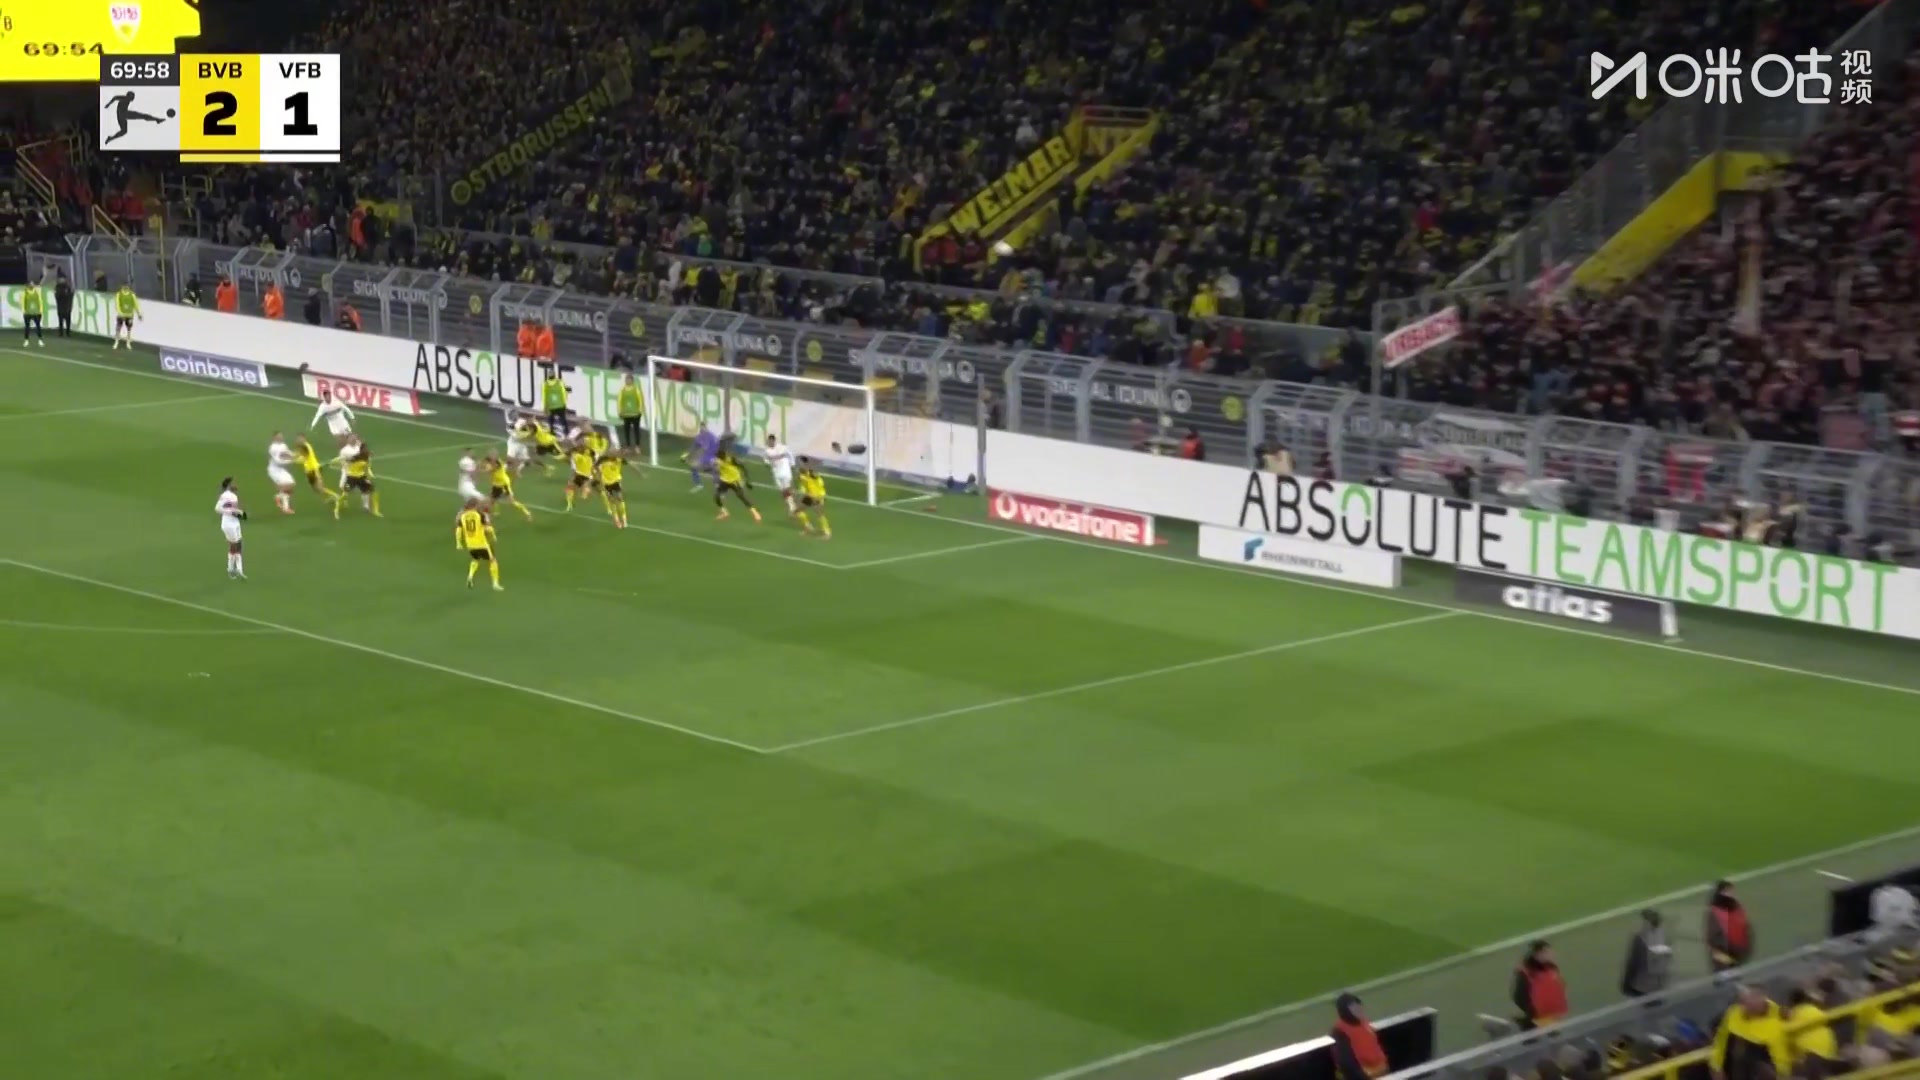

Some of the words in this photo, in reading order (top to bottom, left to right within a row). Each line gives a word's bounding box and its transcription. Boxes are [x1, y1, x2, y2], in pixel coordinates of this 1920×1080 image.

[164, 354, 257, 385] coinbase
[413, 343, 577, 415] ABSOLUE
[316, 379, 392, 411] ROWE
[1017, 505, 1140, 540] vodafone
[1240, 470, 1508, 569] ABSOLUTE
[1519, 510, 1898, 632] TEAMSPORT
[1502, 584, 1612, 624] atlas
